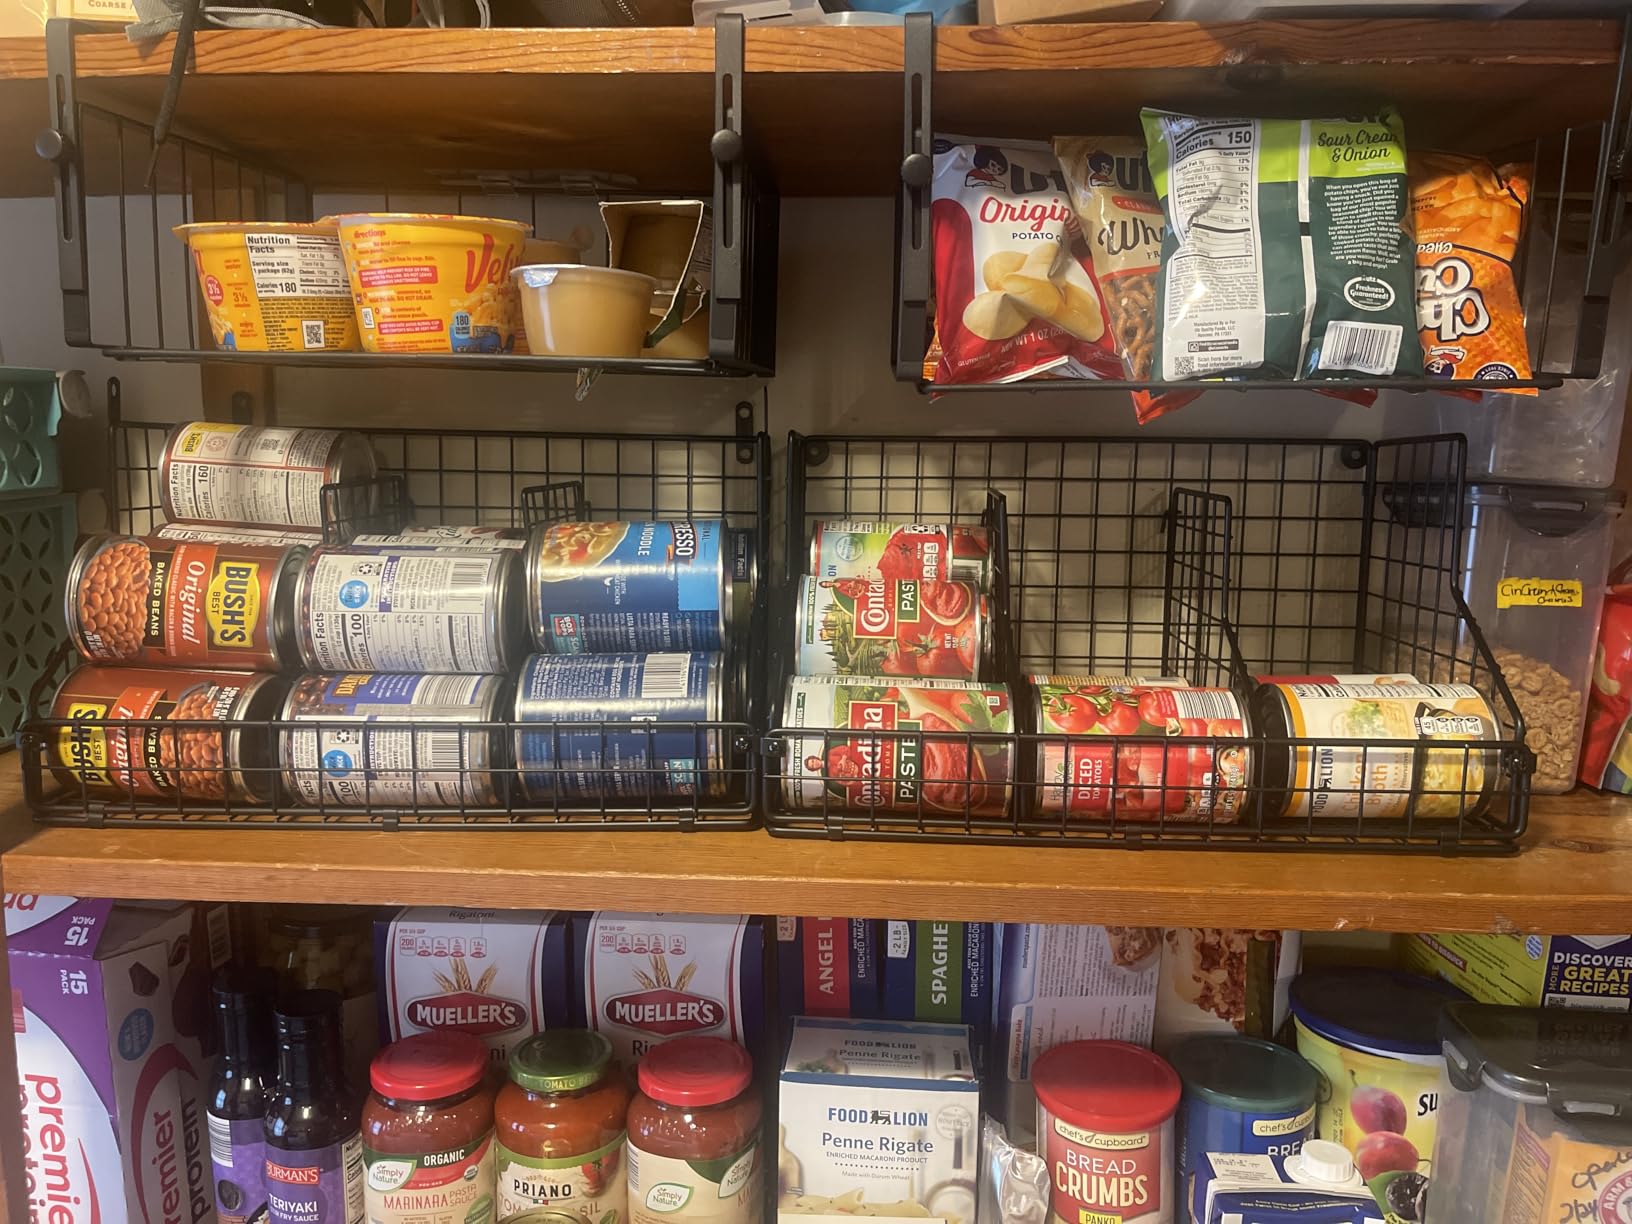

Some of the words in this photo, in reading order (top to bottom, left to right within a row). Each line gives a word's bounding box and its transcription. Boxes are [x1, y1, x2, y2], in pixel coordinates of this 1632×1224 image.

[1176, 138, 1214, 160] Calories
[1227, 131, 1252, 144] 150
[1318, 131, 1353, 147] Sour
[1332, 148, 1341, 162] &
[1343, 146, 1391, 161] Onion
[247, 236, 291, 245] Nutrition
[1012, 232, 1054, 241] POTATO
[249, 246, 275, 254] Facts
[257, 282, 278, 290] Calories
[279, 282, 297, 294] 180
[1350, 289, 1389, 300] Guaranteed!
[1355, 283, 1385, 293] Freshness
[455, 315, 469, 326] 180
[1030, 330, 1035, 343] 1
[1037, 328, 1049, 342] OZ
[170, 464, 179, 487] Facts
[198, 465, 209, 483] 160
[171, 487, 182, 517] Nutrition
[203, 491, 213, 519] Calories
[638, 527, 655, 556] NOODLE
[736, 558, 745, 576] Facts
[153, 561, 166, 596] BAKED
[178, 560, 207, 644] Original
[211, 591, 221, 615] BEST
[220, 566, 252, 643] BUSH'S
[150, 600, 161, 636] BEANS
[315, 612, 325, 631] Facts
[350, 613, 362, 638] 100
[557, 618, 567, 636] TOPS
[564, 616, 574, 633] BOX
[626, 613, 634, 626] LISTA
[661, 612, 669, 630] READY
[315, 632, 334, 669] Nutrition
[358, 642, 372, 669] Calories
[94, 738, 102, 761] BEST
[794, 758, 802, 776] FRESH
[899, 738, 916, 798] PASTE
[1320, 748, 1334, 776] LION
[71, 915, 95, 925] PACK
[449, 910, 495, 920] Rigatoni
[64, 927, 89, 946] 15
[401, 938, 414, 946] 200
[601, 935, 614, 943] 200
[818, 927, 834, 994] ANGEL
[857, 942, 865, 978] ENRICHED
[1553, 952, 1632, 968] DISCOVER
[59, 969, 69, 995] PACK
[68, 969, 88, 995] 15
[970, 962, 979, 997] ENRICHED
[1549, 965, 1560, 991] MORE
[1564, 966, 1632, 982] GREAT
[1559, 980, 1630, 996] RECIPES
[416, 1003, 516, 1026] MUELLER'S
[615, 1001, 714, 1024] MUELLER'S
[844, 1039, 875, 1048] FOOD
[889, 1042, 917, 1050] LION
[839, 1049, 877, 1058] Penne
[881, 1051, 921, 1061] Rigate
[828, 1107, 868, 1124] FOOD
[893, 1112, 928, 1127] LION
[1059, 1124, 1084, 1142] chef's
[1094, 1135, 1143, 1147] cupboard
[1259, 1123, 1287, 1133] chef's
[822, 1132, 874, 1150] Penne
[879, 1137, 934, 1155] Rigate
[182, 1097, 211, 1224] protein
[423, 1149, 465, 1166] ORGANIC
[826, 1151, 858, 1160] ENRICHED
[859, 1153, 895, 1163] MACARONI
[896, 1156, 928, 1164] PRODUCT
[1066, 1149, 1137, 1175] BREAD
[266, 1161, 320, 1184] BURMAN'S
[372, 1173, 398, 1185] Nature
[376, 1165, 404, 1178] Simply
[727, 1170, 749, 1187] Nature
[842, 1170, 857, 1178] Made
[871, 1172, 891, 1180] Durum
[449, 1184, 477, 1199] PASTA
[514, 1179, 572, 1197] PRIANO
[1055, 1161, 1148, 1208] CRUMBS
[269, 1193, 317, 1213] TERIYAKI
[384, 1194, 449, 1210] MARINARA
[450, 1192, 478, 1207] SAUCE
[652, 1195, 678, 1207] Nature
[656, 1190, 683, 1202] Simply
[1603, 1182, 1625, 1210] ARM
[280, 1212, 293, 1221] FRY
[293, 1213, 319, 1222] SAUCE
